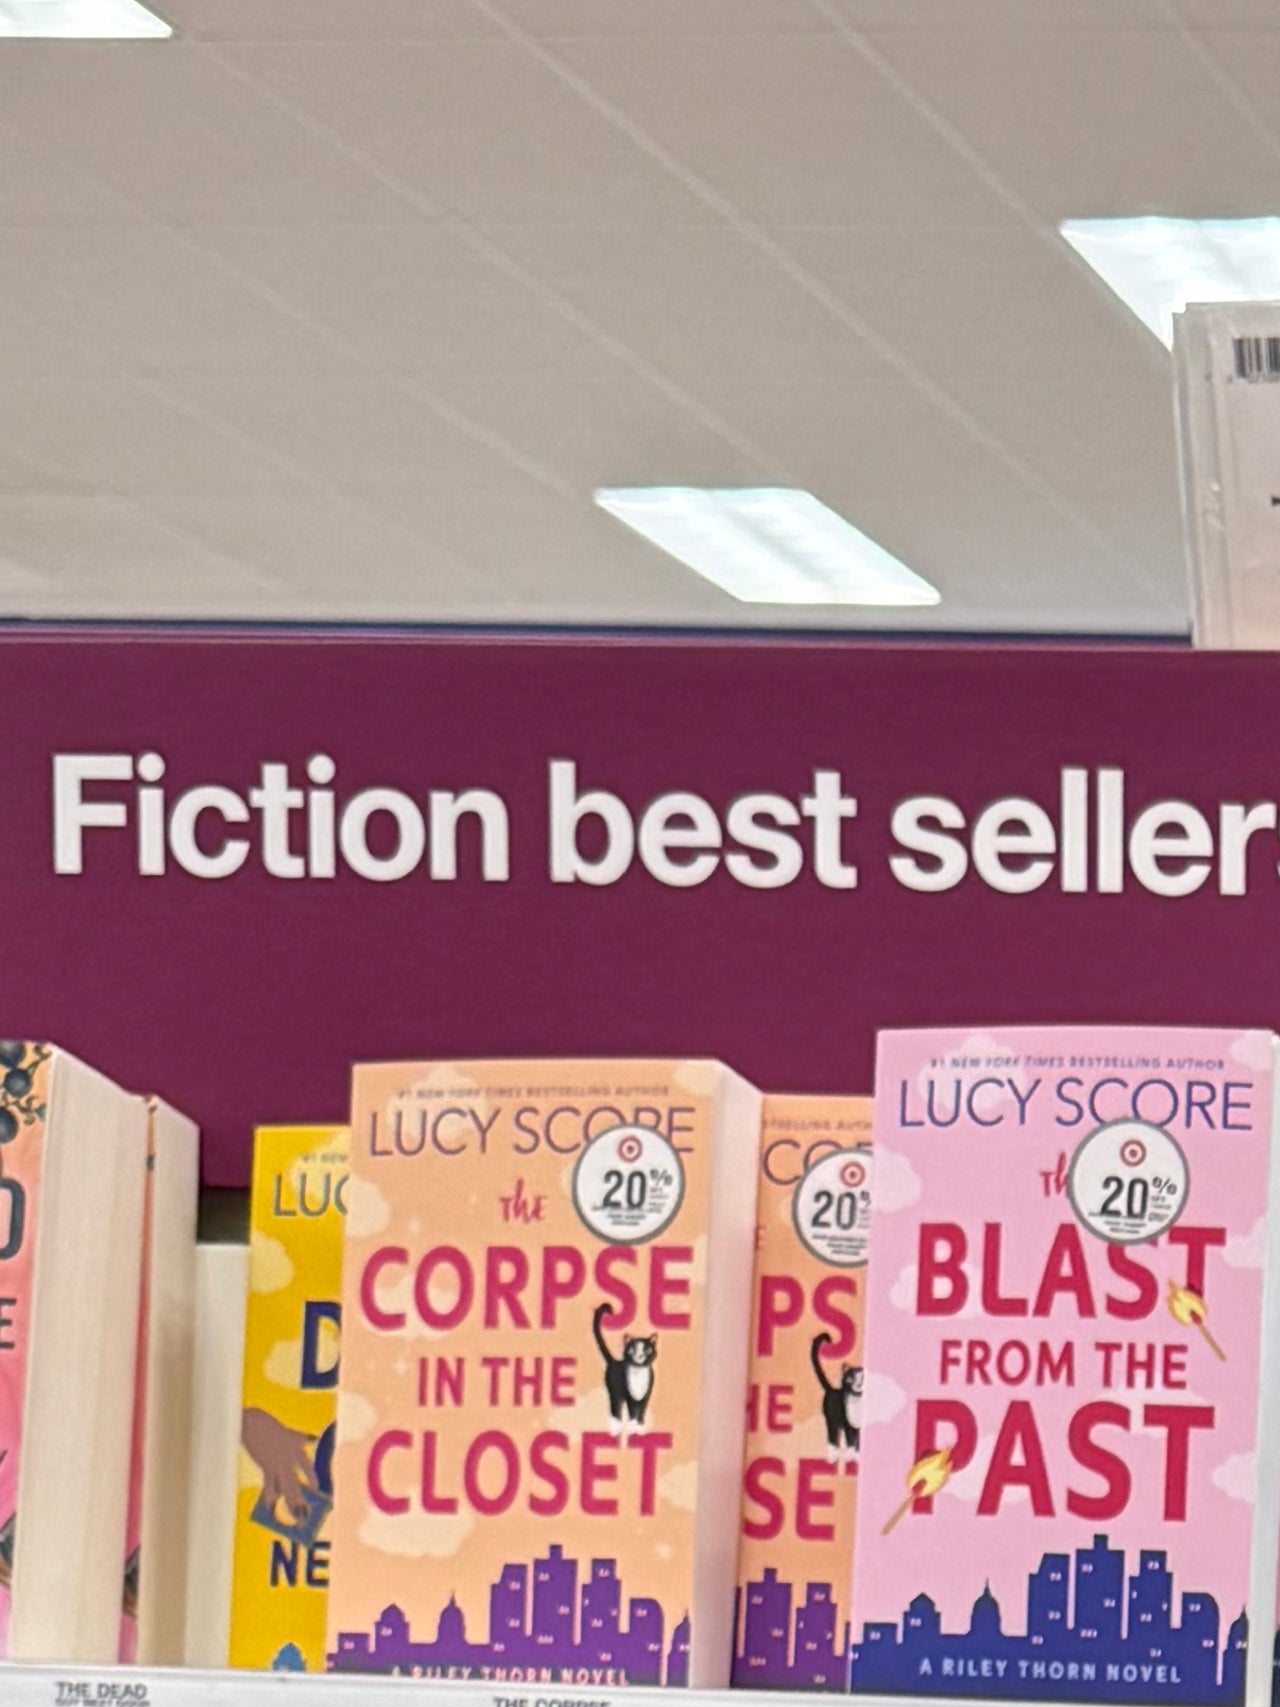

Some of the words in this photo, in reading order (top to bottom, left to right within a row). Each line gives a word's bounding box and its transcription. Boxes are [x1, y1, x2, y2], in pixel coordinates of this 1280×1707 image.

[52, 752, 509, 880] Fiction
[549, 760, 856, 888] best
[900, 1077, 1040, 1127] LUCY
[1056, 1079, 1253, 1130] SCORE
[370, 1108, 500, 1156] LUCY
[359, 1246, 695, 1331] CORPSE
[916, 1222, 1226, 1320] BLAST
[418, 1357, 464, 1406] IN
[483, 1357, 577, 1407] THE
[940, 1340, 1074, 1386] FROM
[1095, 1344, 1187, 1387] THE
[367, 1431, 672, 1516] CLOSET
[910, 1400, 1215, 1522] PAST
[56, 1682, 92, 1700] THE
[98, 1683, 146, 1700] DEAD
[920, 1659, 931, 1675] A
[941, 1659, 1006, 1677] RILEY
[1020, 1660, 1096, 1680] THORN
[1107, 1664, 1181, 1683] NOVEL
